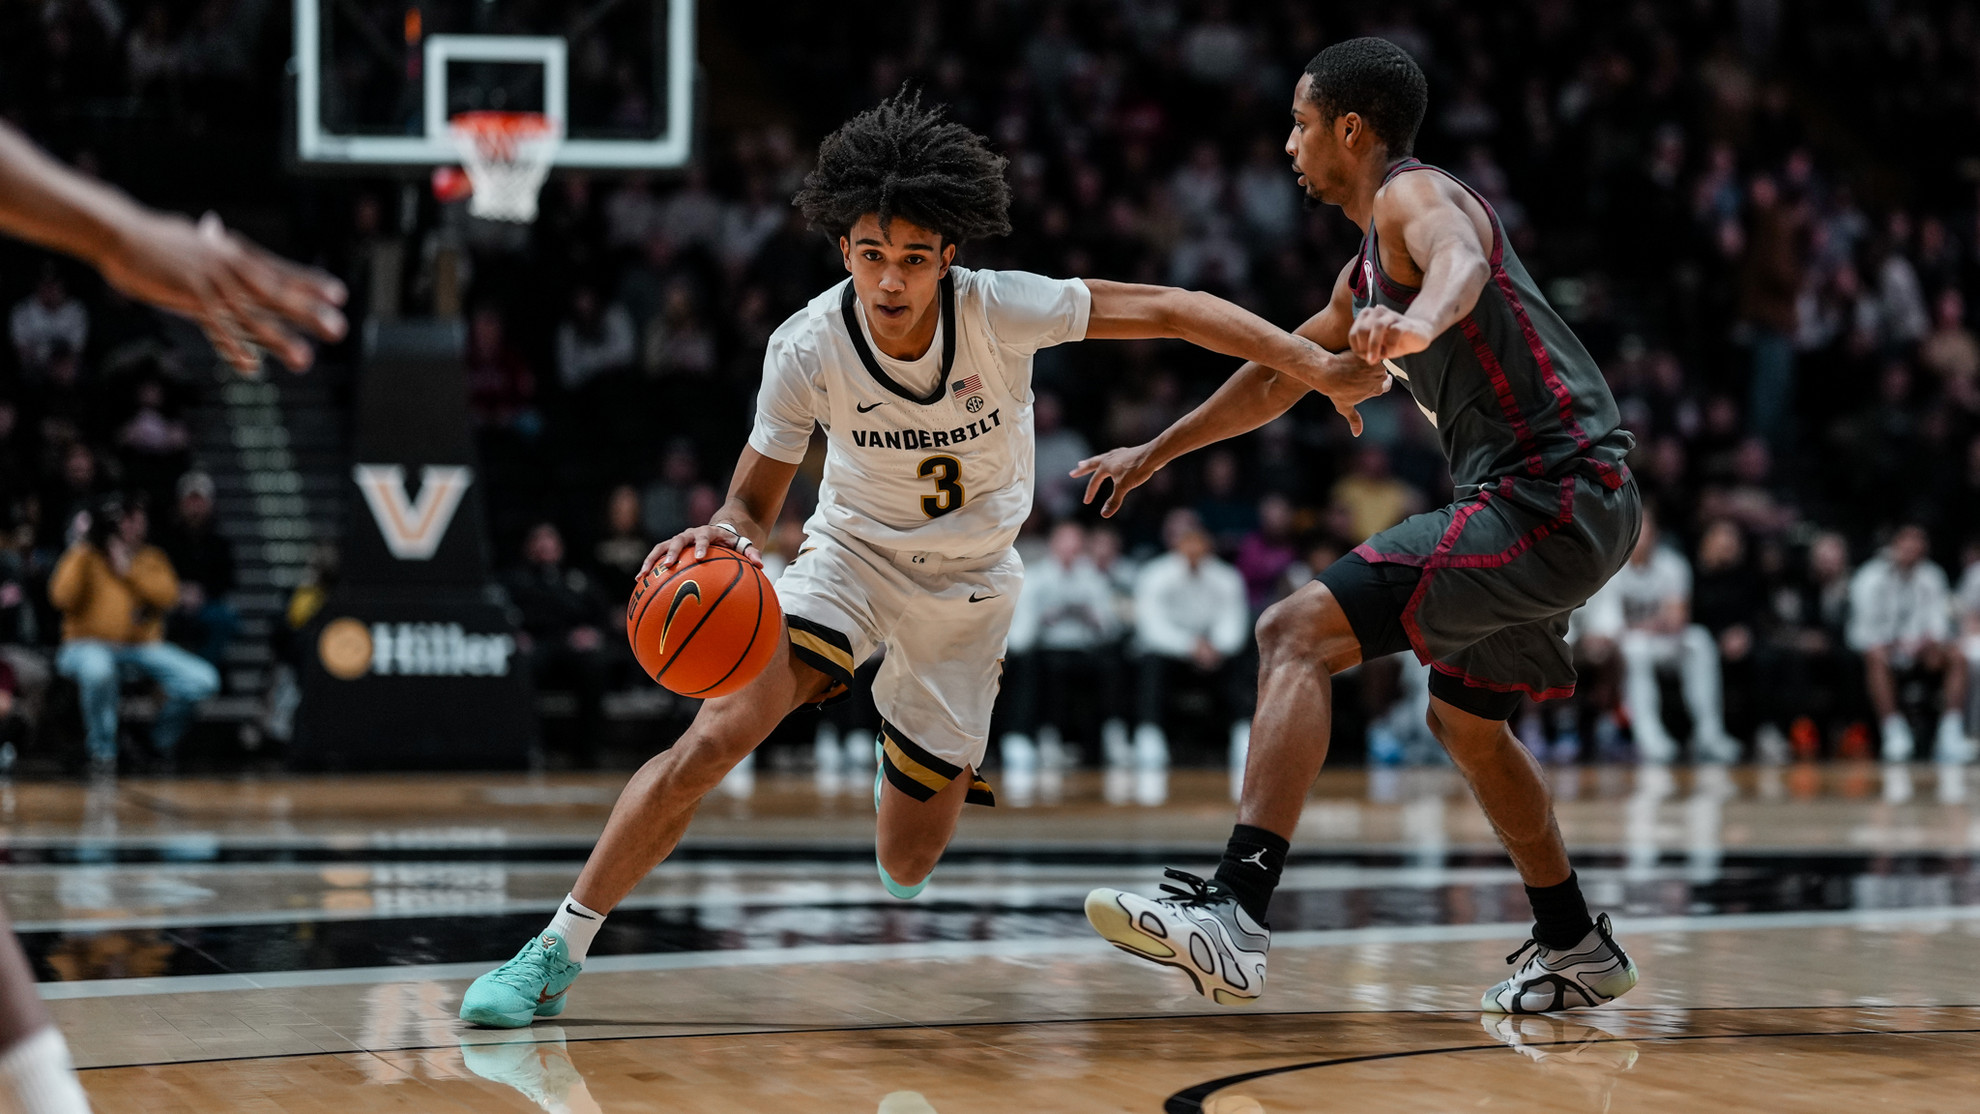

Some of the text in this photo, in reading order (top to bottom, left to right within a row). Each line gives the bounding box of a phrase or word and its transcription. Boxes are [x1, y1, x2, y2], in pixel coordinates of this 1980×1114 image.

[852, 409, 1000, 450] VANDERBILT
[967, 396, 983, 412] SEC
[353, 463, 474, 561] V
[917, 455, 965, 519] 3
[371, 622, 514, 677] Hiller
